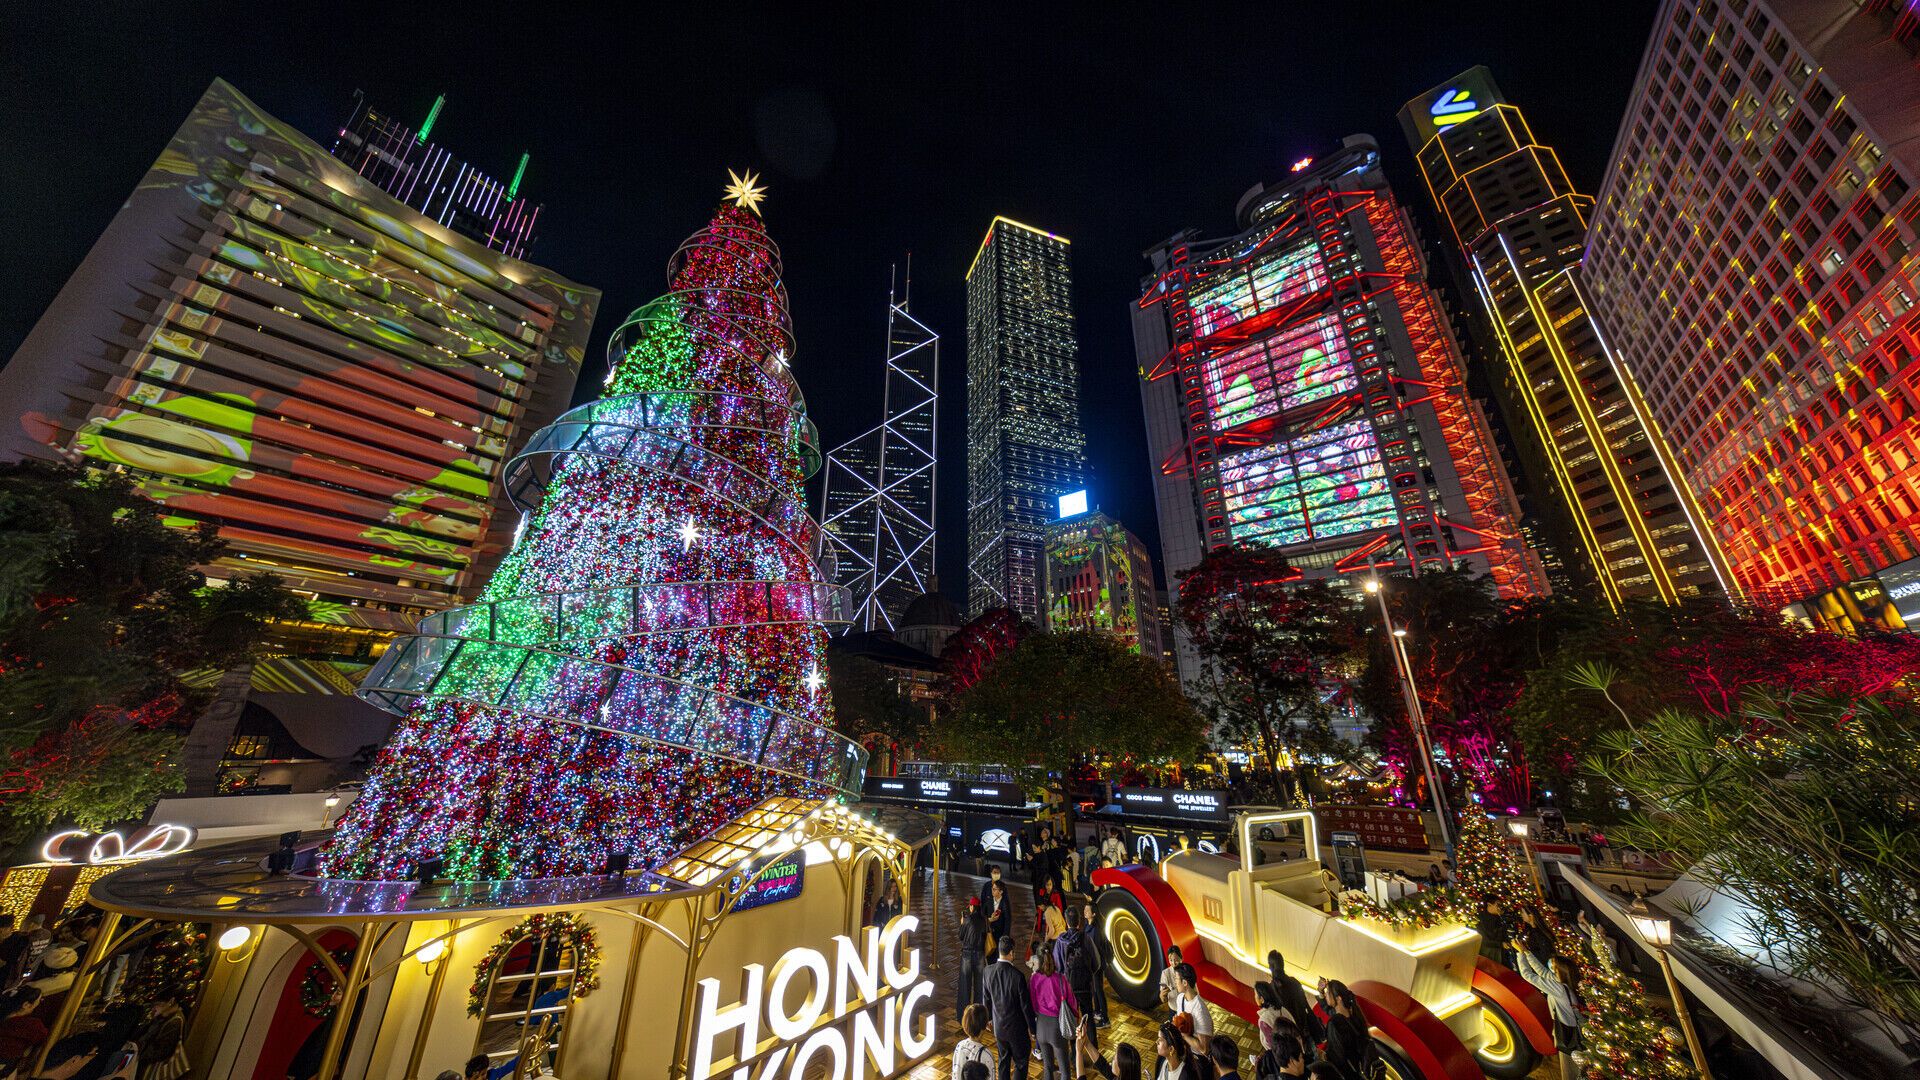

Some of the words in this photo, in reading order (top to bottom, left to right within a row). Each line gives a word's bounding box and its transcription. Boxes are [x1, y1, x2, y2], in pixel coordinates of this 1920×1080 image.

[921, 780, 951, 792] CHANEL
[1172, 793, 1219, 806] CHANEL
[760, 863, 798, 880] WINTER
[692, 915, 920, 1080] HONG
